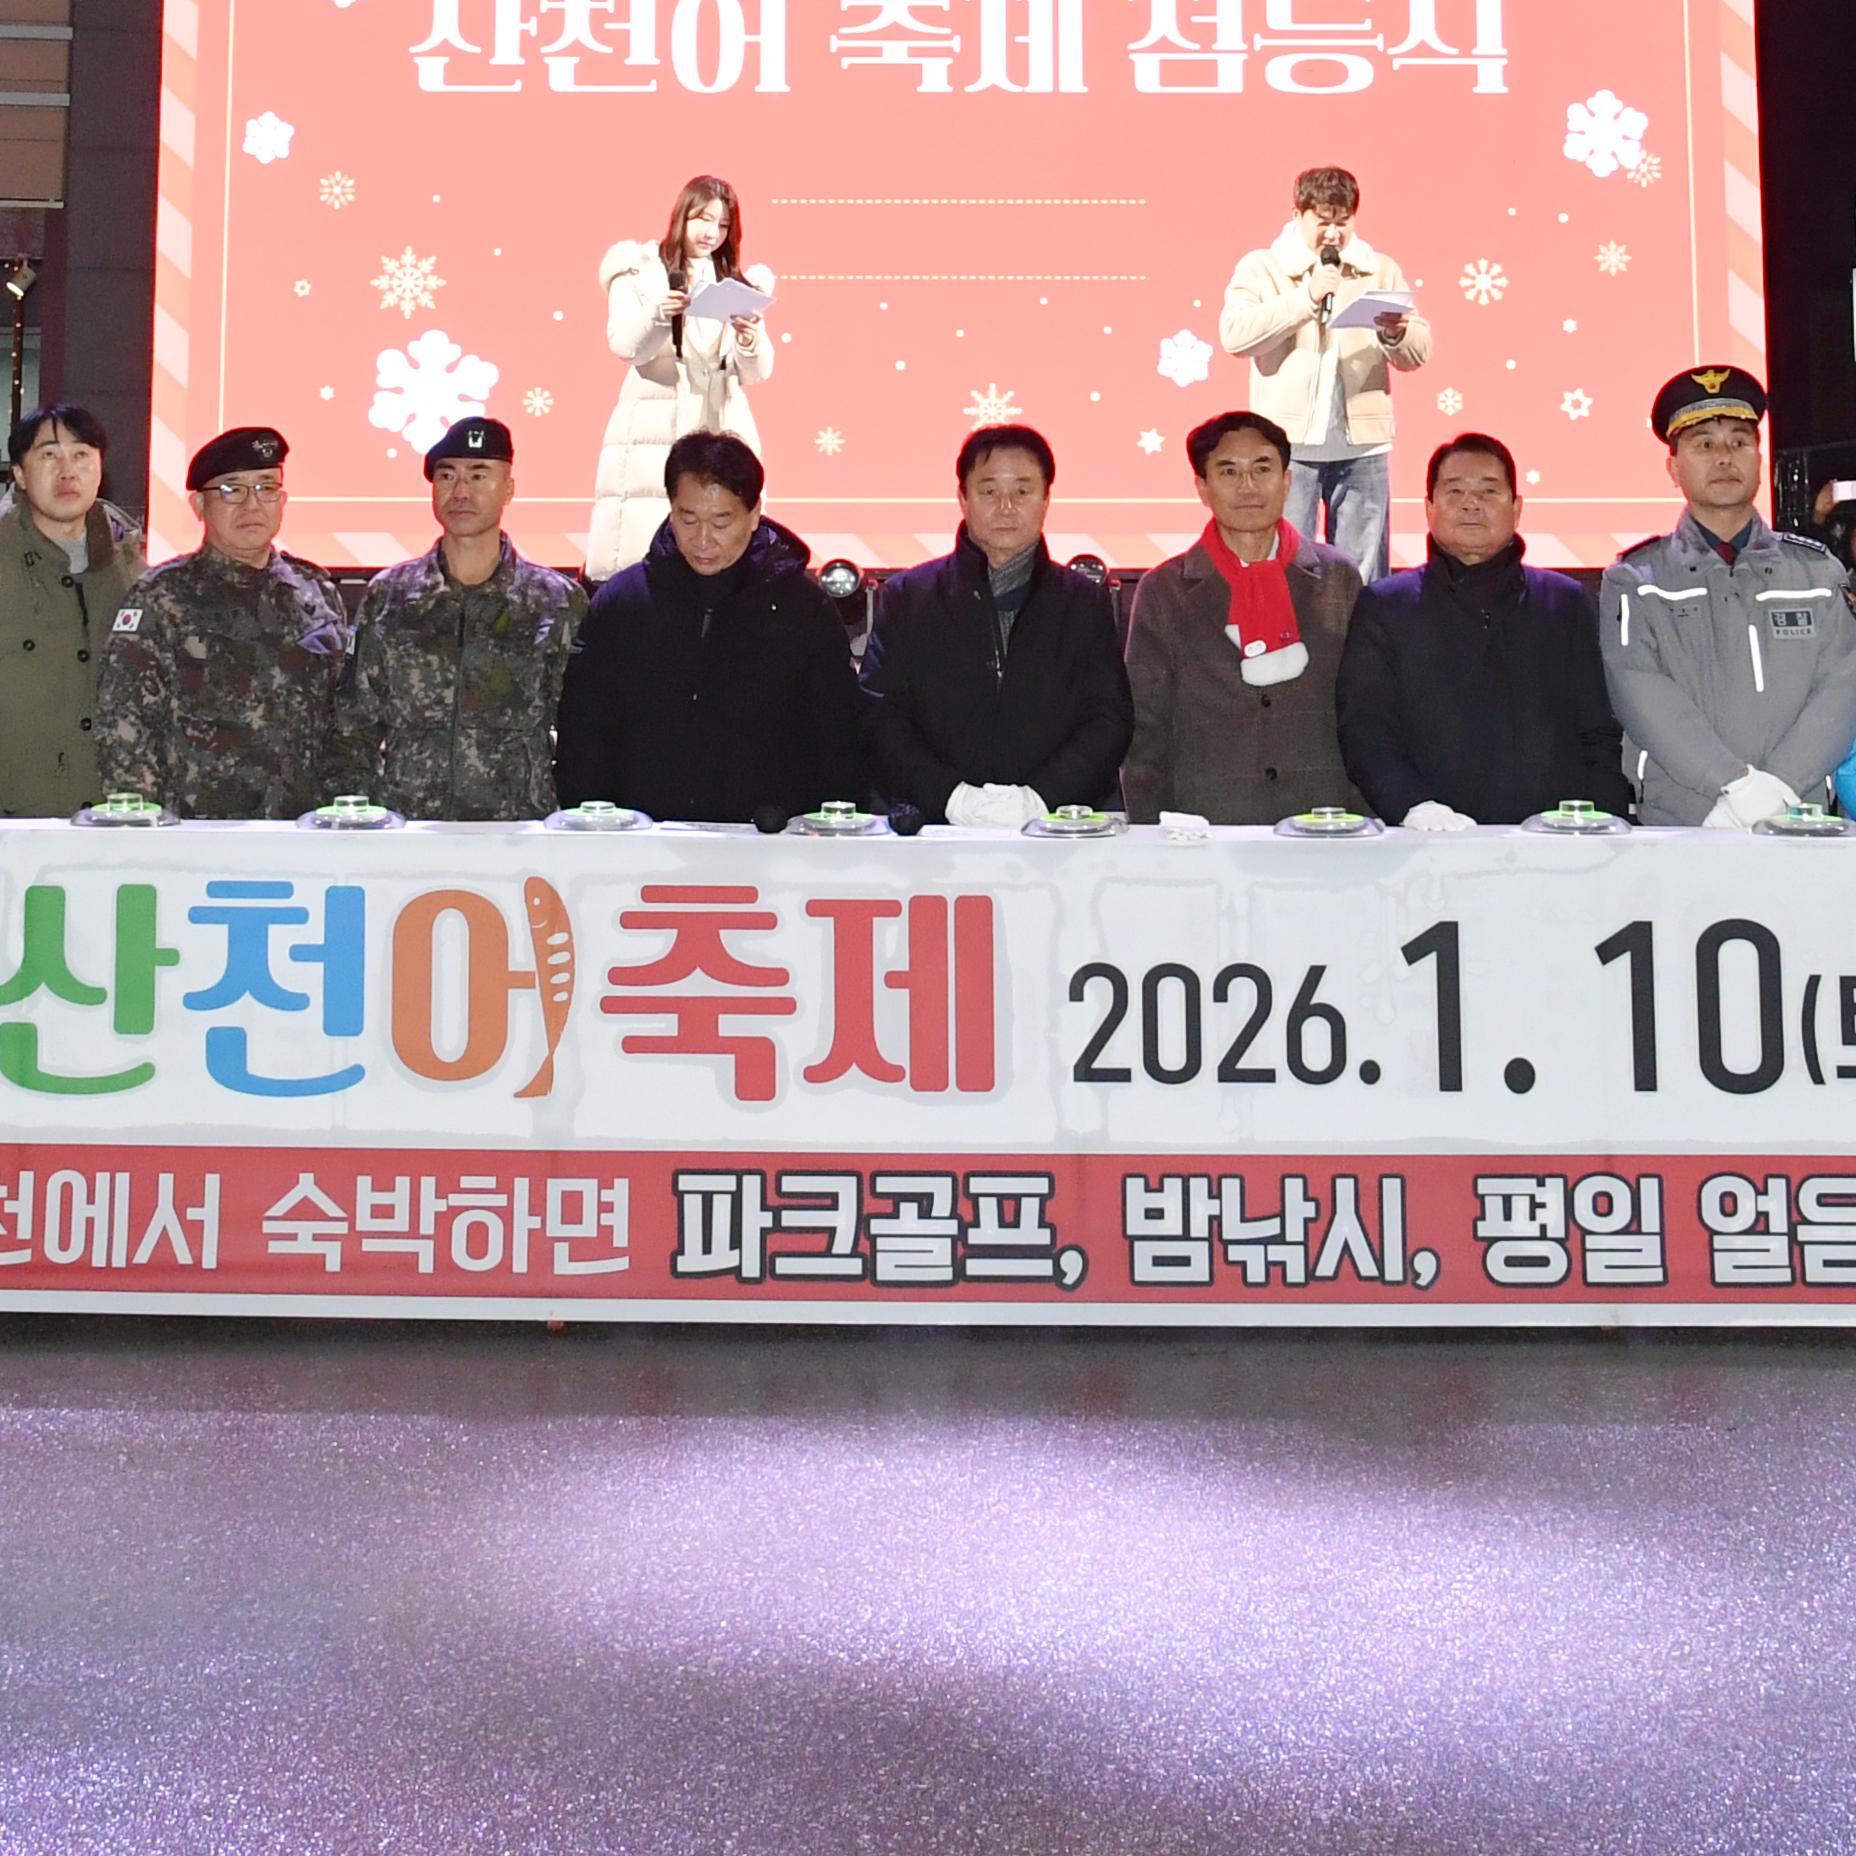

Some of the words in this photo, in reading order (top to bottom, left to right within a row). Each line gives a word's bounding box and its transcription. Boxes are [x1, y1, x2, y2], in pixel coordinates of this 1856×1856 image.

[261, 1172, 630, 1276] 숙박하면
[672, 1170, 1089, 1289] 파크골프,
[1126, 1175, 1440, 1291] 밤낚시,
[1476, 1175, 1665, 1285] 평일
